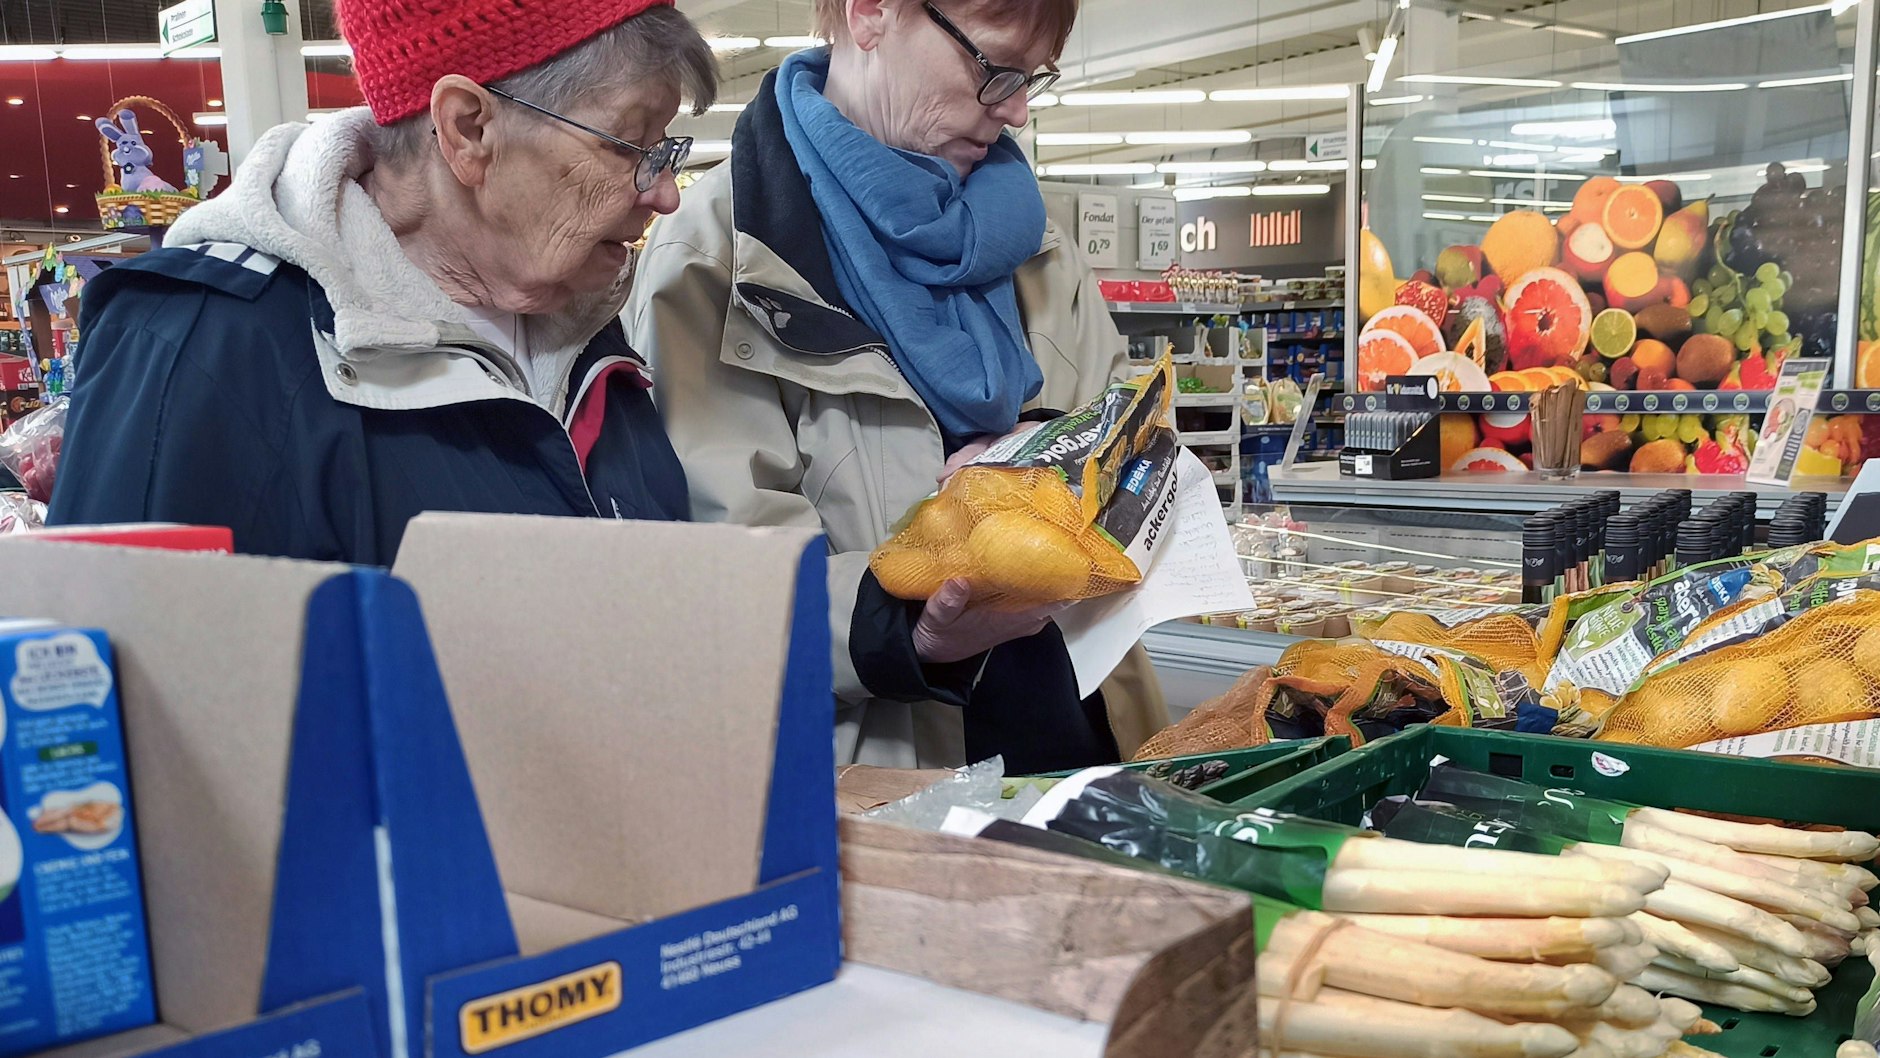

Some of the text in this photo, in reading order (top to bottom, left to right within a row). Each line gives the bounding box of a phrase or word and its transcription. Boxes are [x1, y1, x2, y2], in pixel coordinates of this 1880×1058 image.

[1083, 211, 1114, 224] Fondat
[1088, 239, 1110, 255] 0.79
[1180, 216, 1216, 252] ch
[1150, 241, 1168, 257] 1.69
[1126, 459, 1153, 493] EDEKA
[1711, 576, 1731, 605] DEKA
[1600, 604, 1626, 633] NEUE
[778, 904, 799, 922] AG
[472, 970, 614, 1034] THOMY
